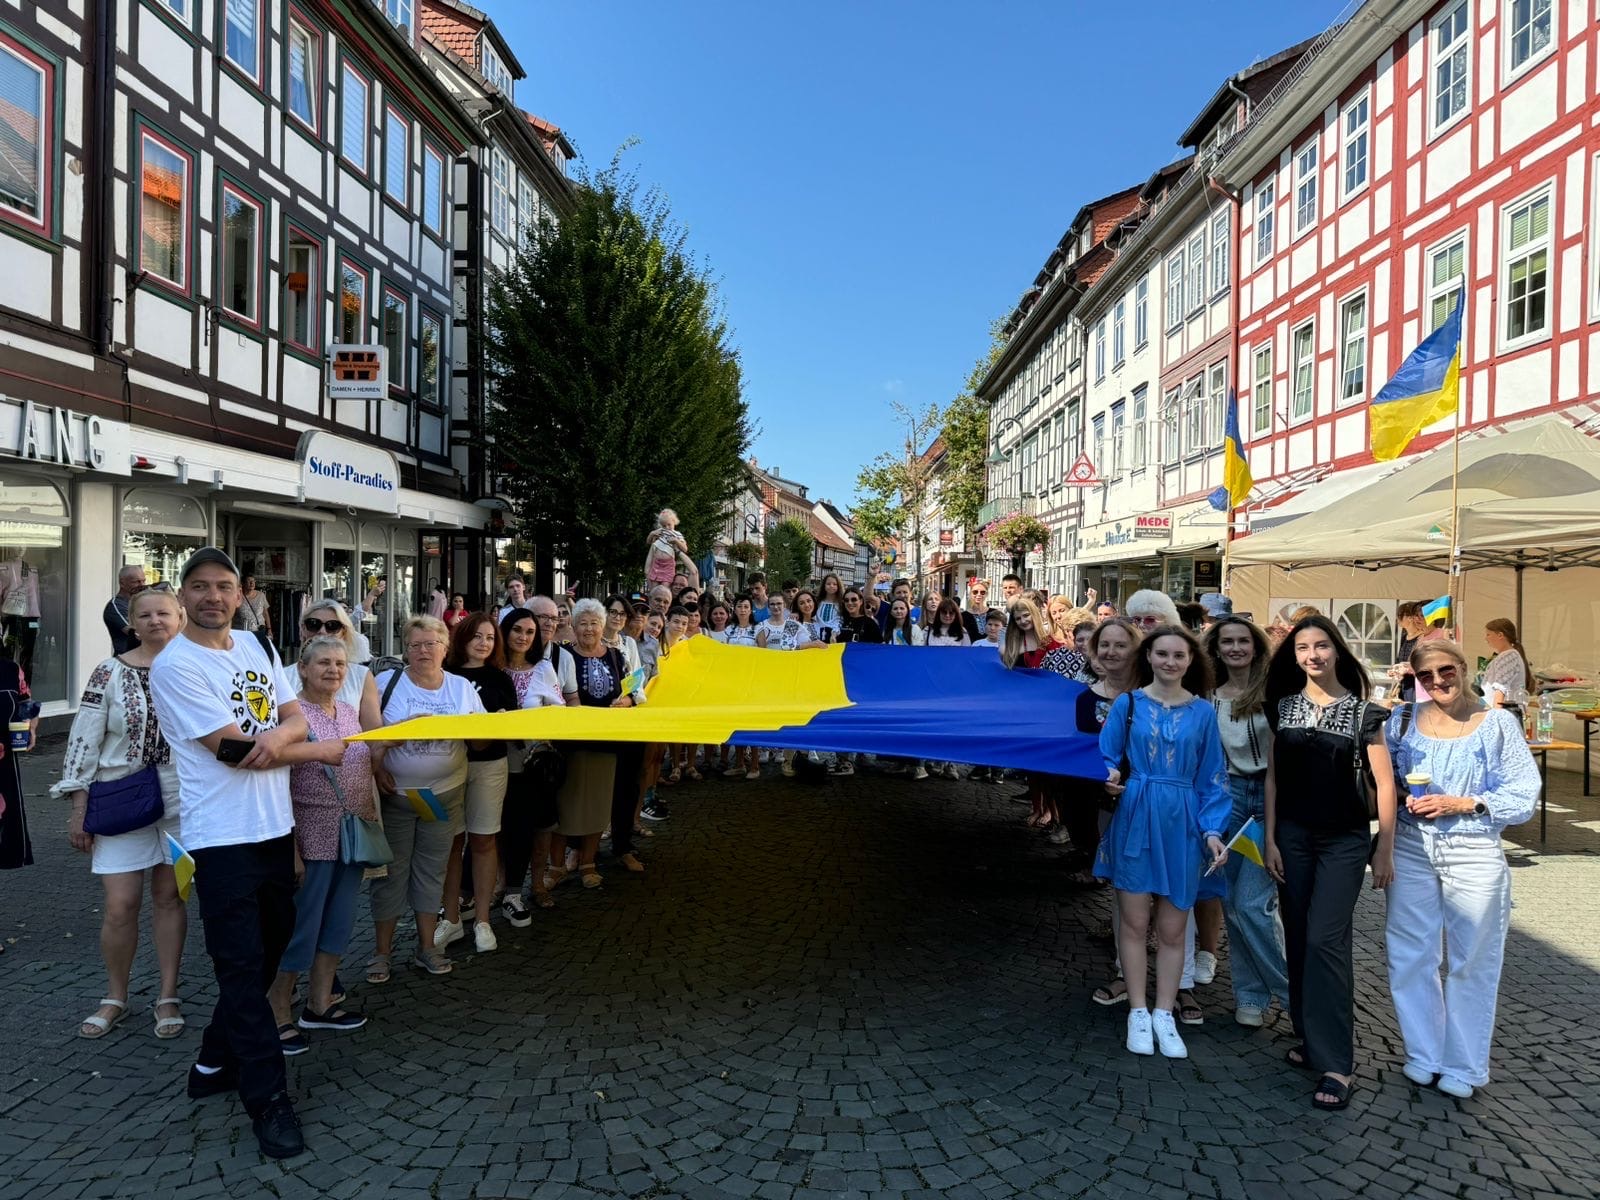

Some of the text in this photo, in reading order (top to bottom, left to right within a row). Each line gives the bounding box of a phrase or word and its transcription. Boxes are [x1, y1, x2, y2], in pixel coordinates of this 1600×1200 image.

[0, 393, 105, 469] ANG
[310, 456, 393, 491] Stoff-Paradies
[1137, 517, 1169, 526] MEDE
